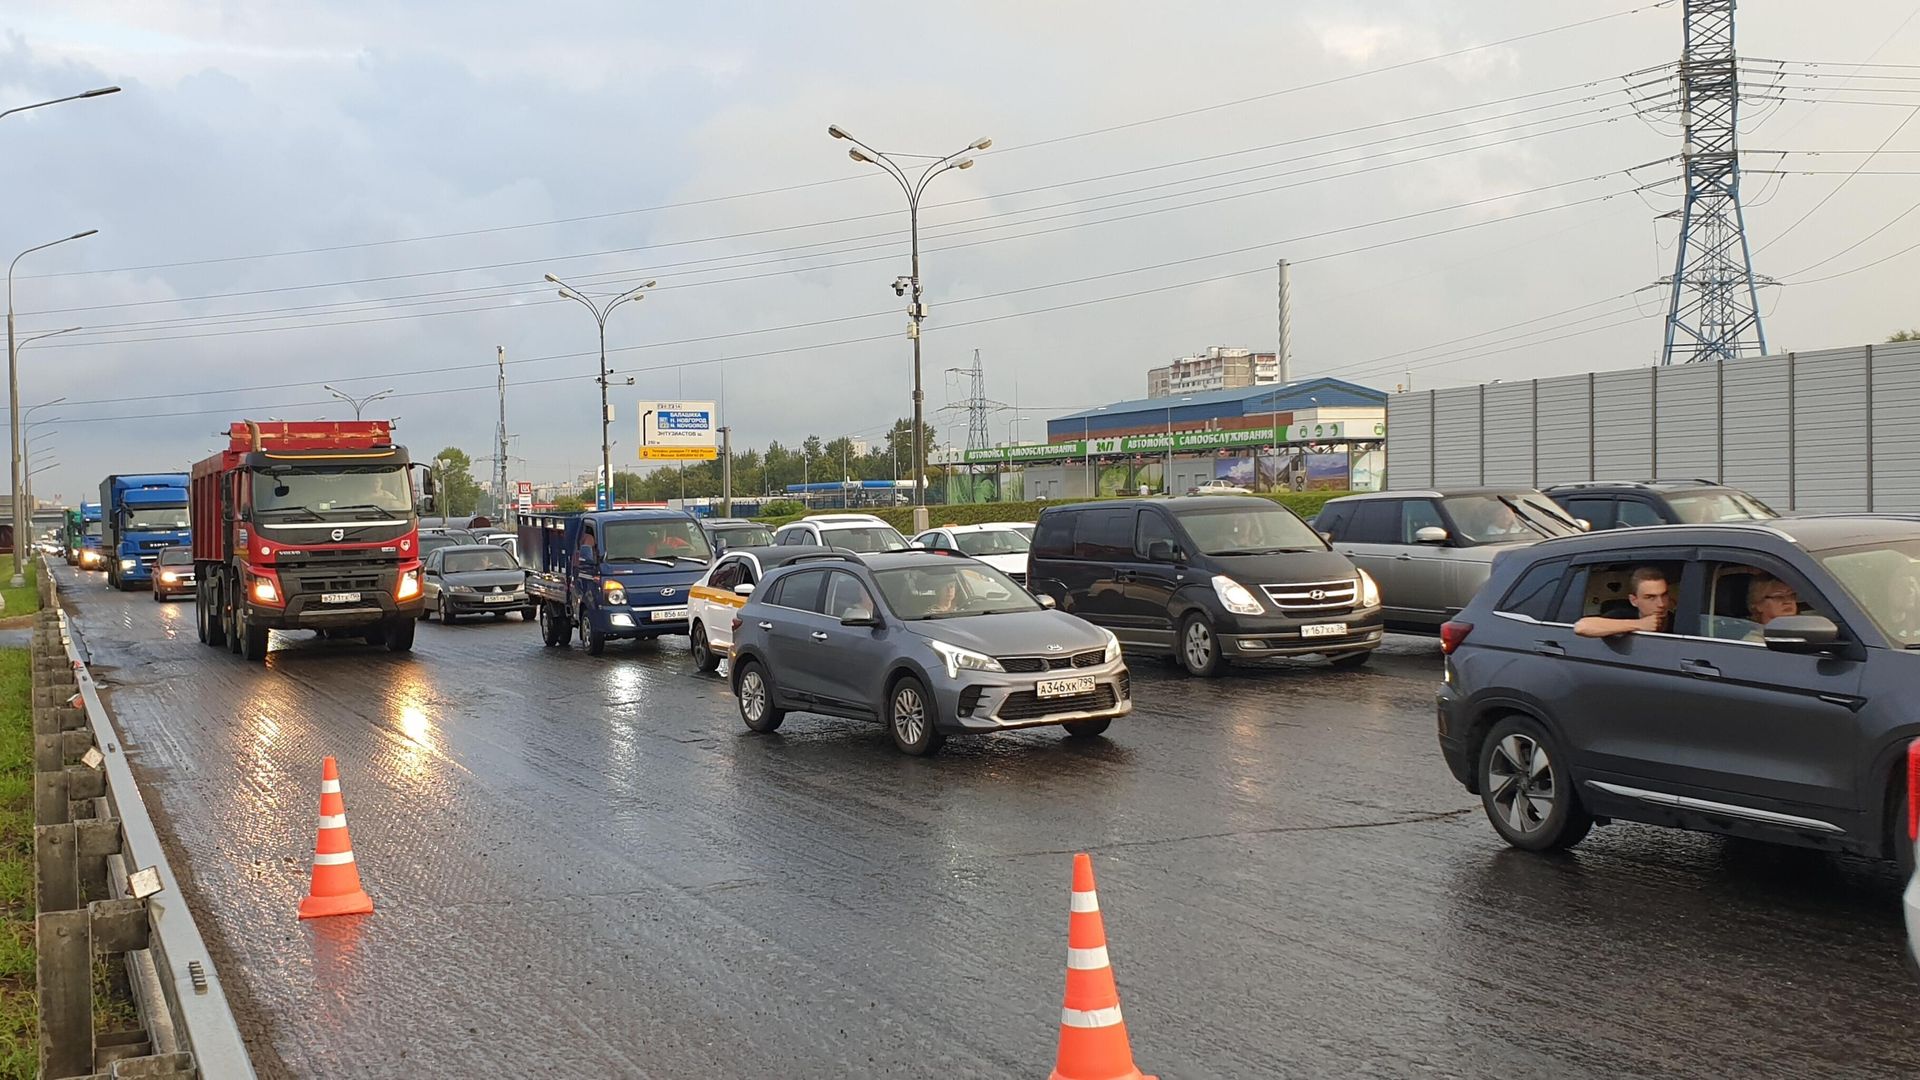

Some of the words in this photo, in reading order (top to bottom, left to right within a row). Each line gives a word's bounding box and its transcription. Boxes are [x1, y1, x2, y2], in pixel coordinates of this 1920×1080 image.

[1127, 435, 1175, 449] АВТОМОЙКА
[1179, 429, 1274, 446] САМООБСЛУЖИВАНИЯ
[968, 448, 1004, 459] АВТОМОЙКА
